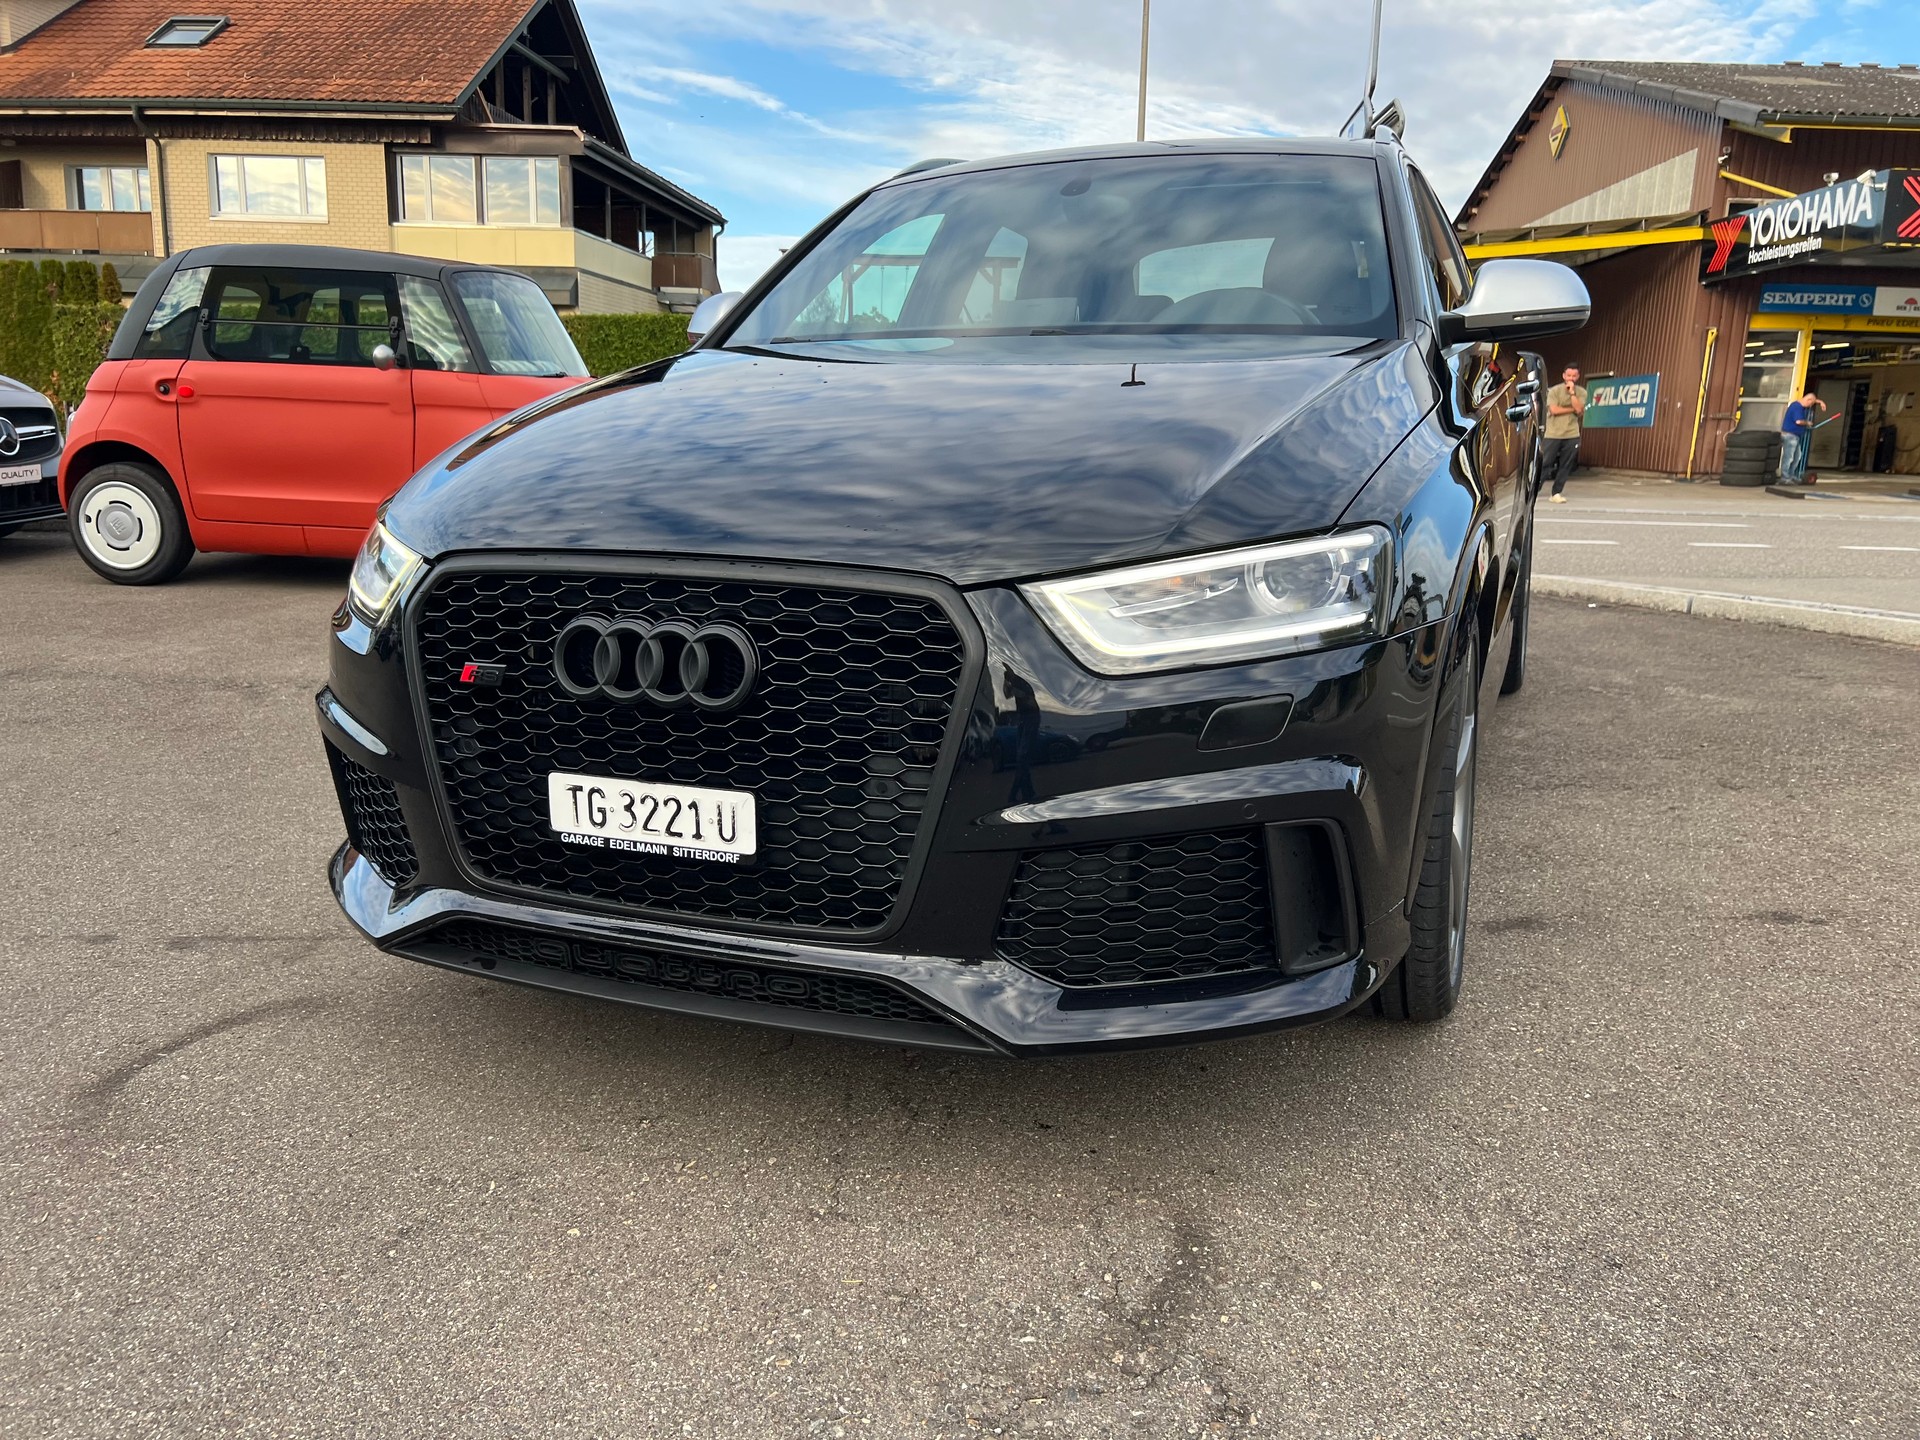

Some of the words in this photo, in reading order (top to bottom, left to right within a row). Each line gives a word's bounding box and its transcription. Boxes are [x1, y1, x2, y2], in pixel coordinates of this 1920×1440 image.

[1749, 184, 1873, 248] YOKOHAMA
[1748, 234, 1822, 265] Hochleistungsreifen
[1762, 292, 1856, 306] SEMPERIT
[1592, 383, 1650, 406] FALKEN
[566, 784, 607, 830] TG
[618, 789, 706, 842] 3221
[715, 801, 738, 845] U
[560, 832, 605, 848] GARAGE
[609, 839, 668, 856] EDELMANN
[672, 846, 740, 864] SITTERDORF
[532, 937, 812, 999] quattro
